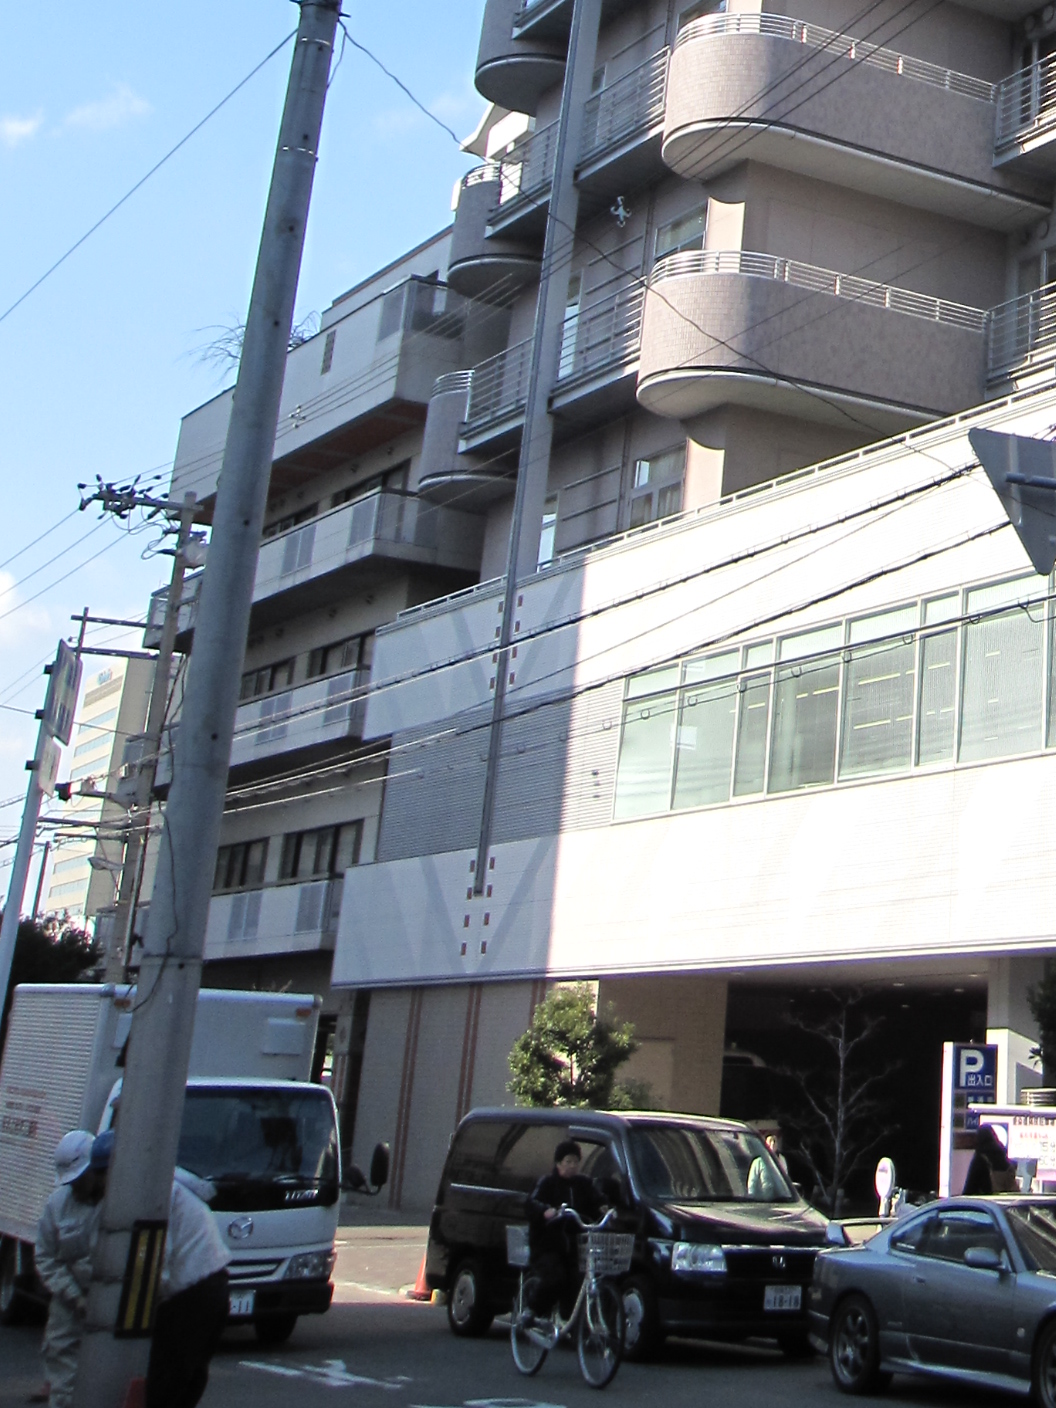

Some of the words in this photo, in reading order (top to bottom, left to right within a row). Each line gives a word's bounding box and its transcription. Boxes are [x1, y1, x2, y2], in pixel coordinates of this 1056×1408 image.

[959, 1048, 985, 1087] P
[967, 1073, 993, 1087] 出入口
